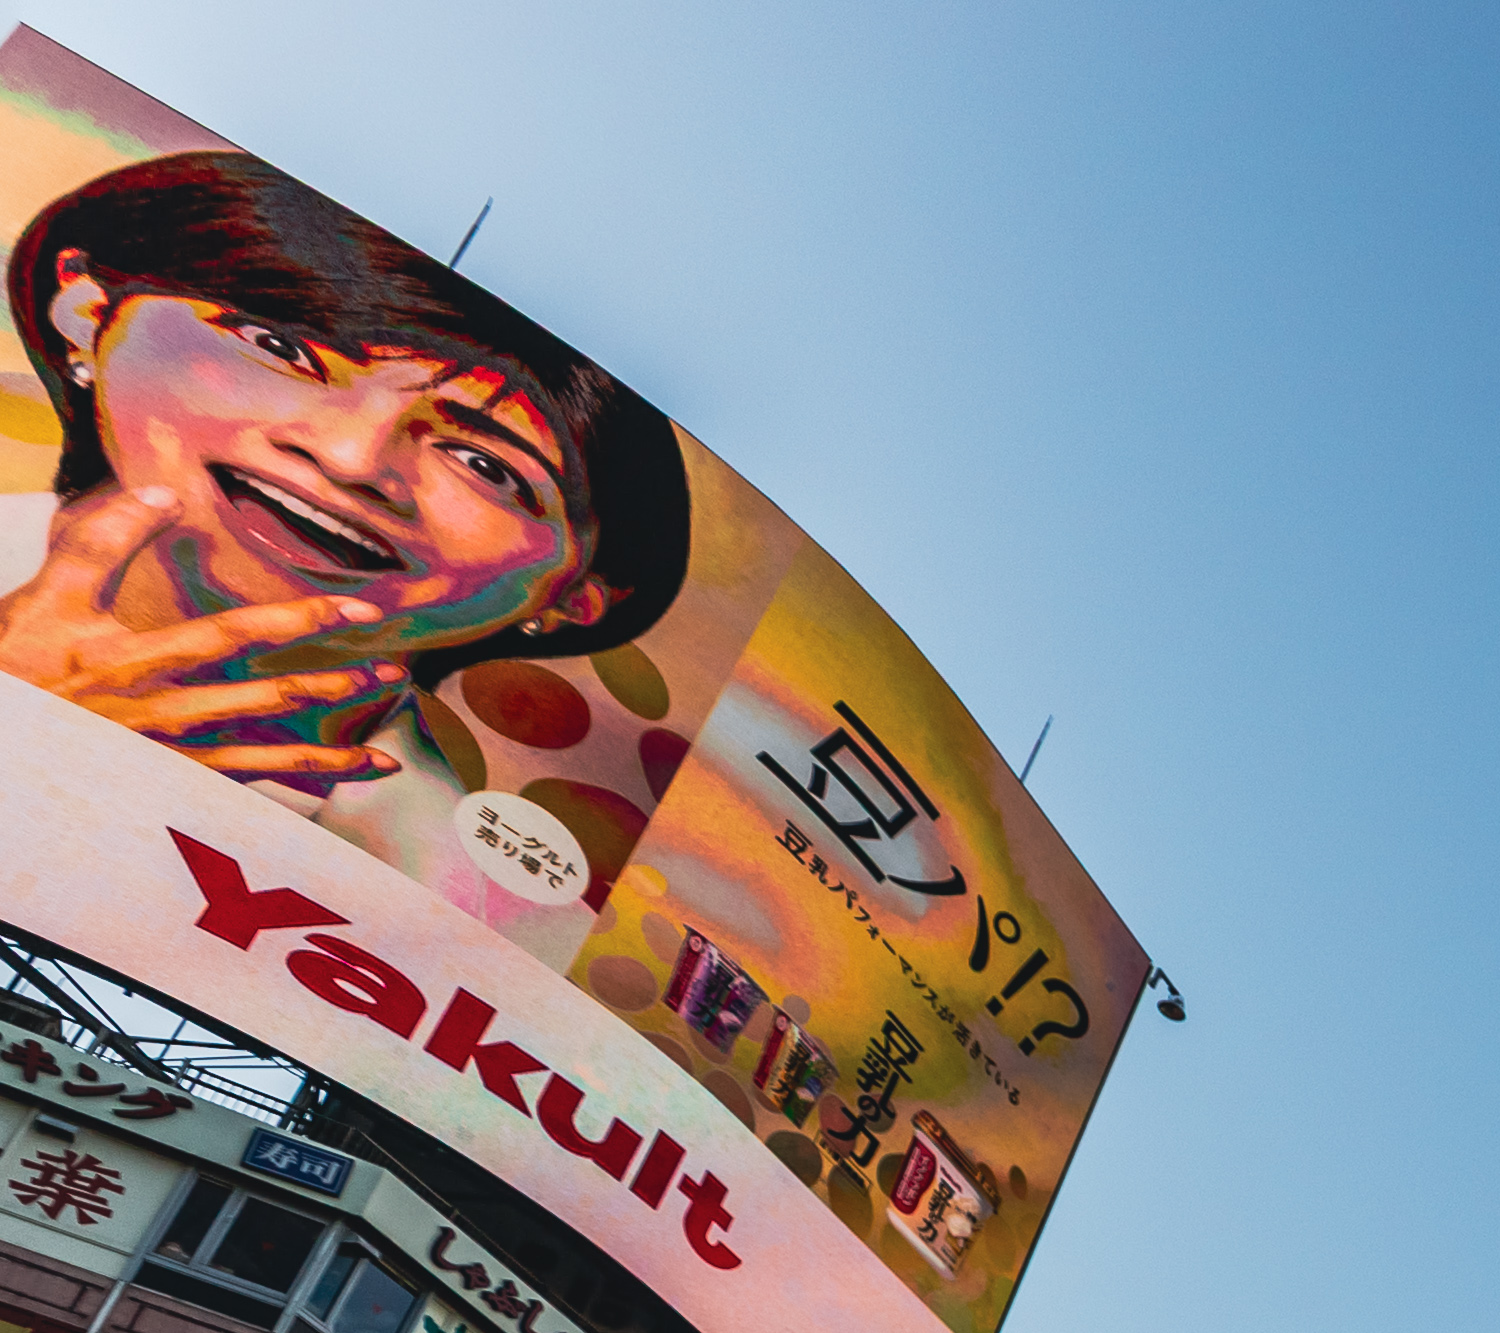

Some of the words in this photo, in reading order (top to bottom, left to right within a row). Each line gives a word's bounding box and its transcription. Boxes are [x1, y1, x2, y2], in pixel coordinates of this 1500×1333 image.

[474, 824, 564, 890] 売り場で
[477, 805, 578, 877] ヨーグルト
[0, 1038, 194, 1120] キング
[166, 825, 743, 1271] Yakult
[255, 1138, 346, 1186] 寿司
